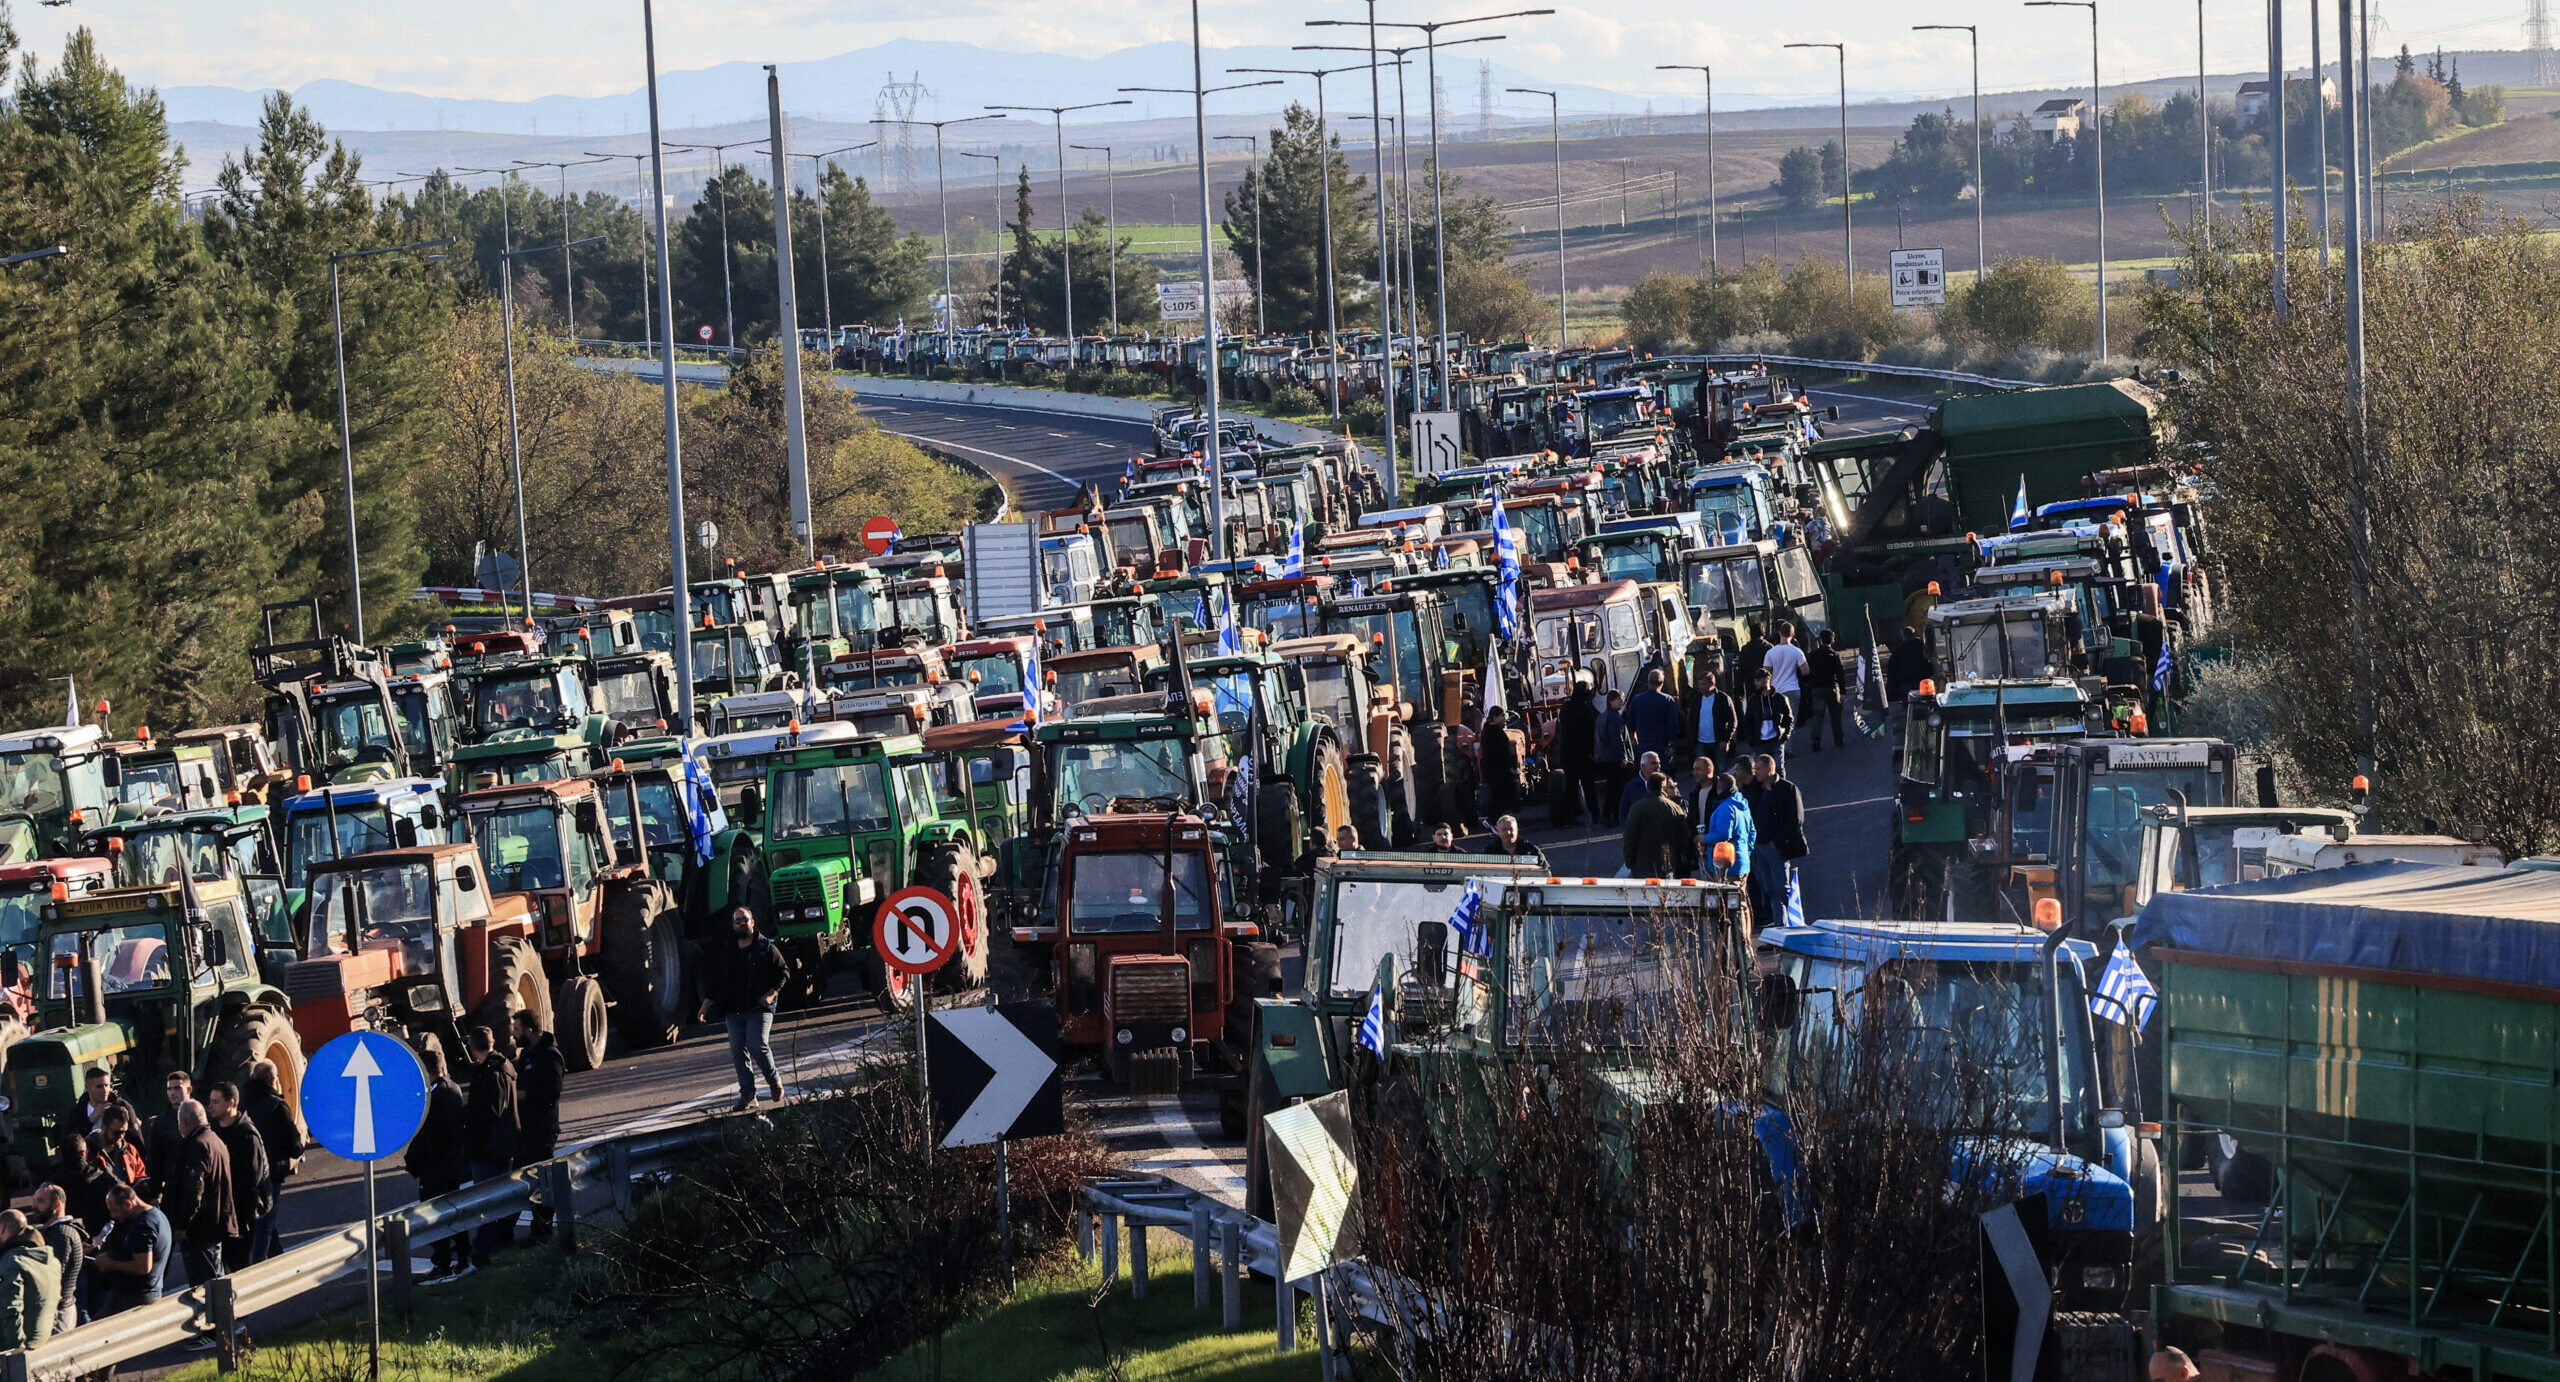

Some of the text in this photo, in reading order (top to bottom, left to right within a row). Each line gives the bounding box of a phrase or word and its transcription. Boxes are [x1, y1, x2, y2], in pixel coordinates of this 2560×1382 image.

[1172, 301, 1196, 312] 1075
[1338, 601, 1387, 613] RENAULT TS
